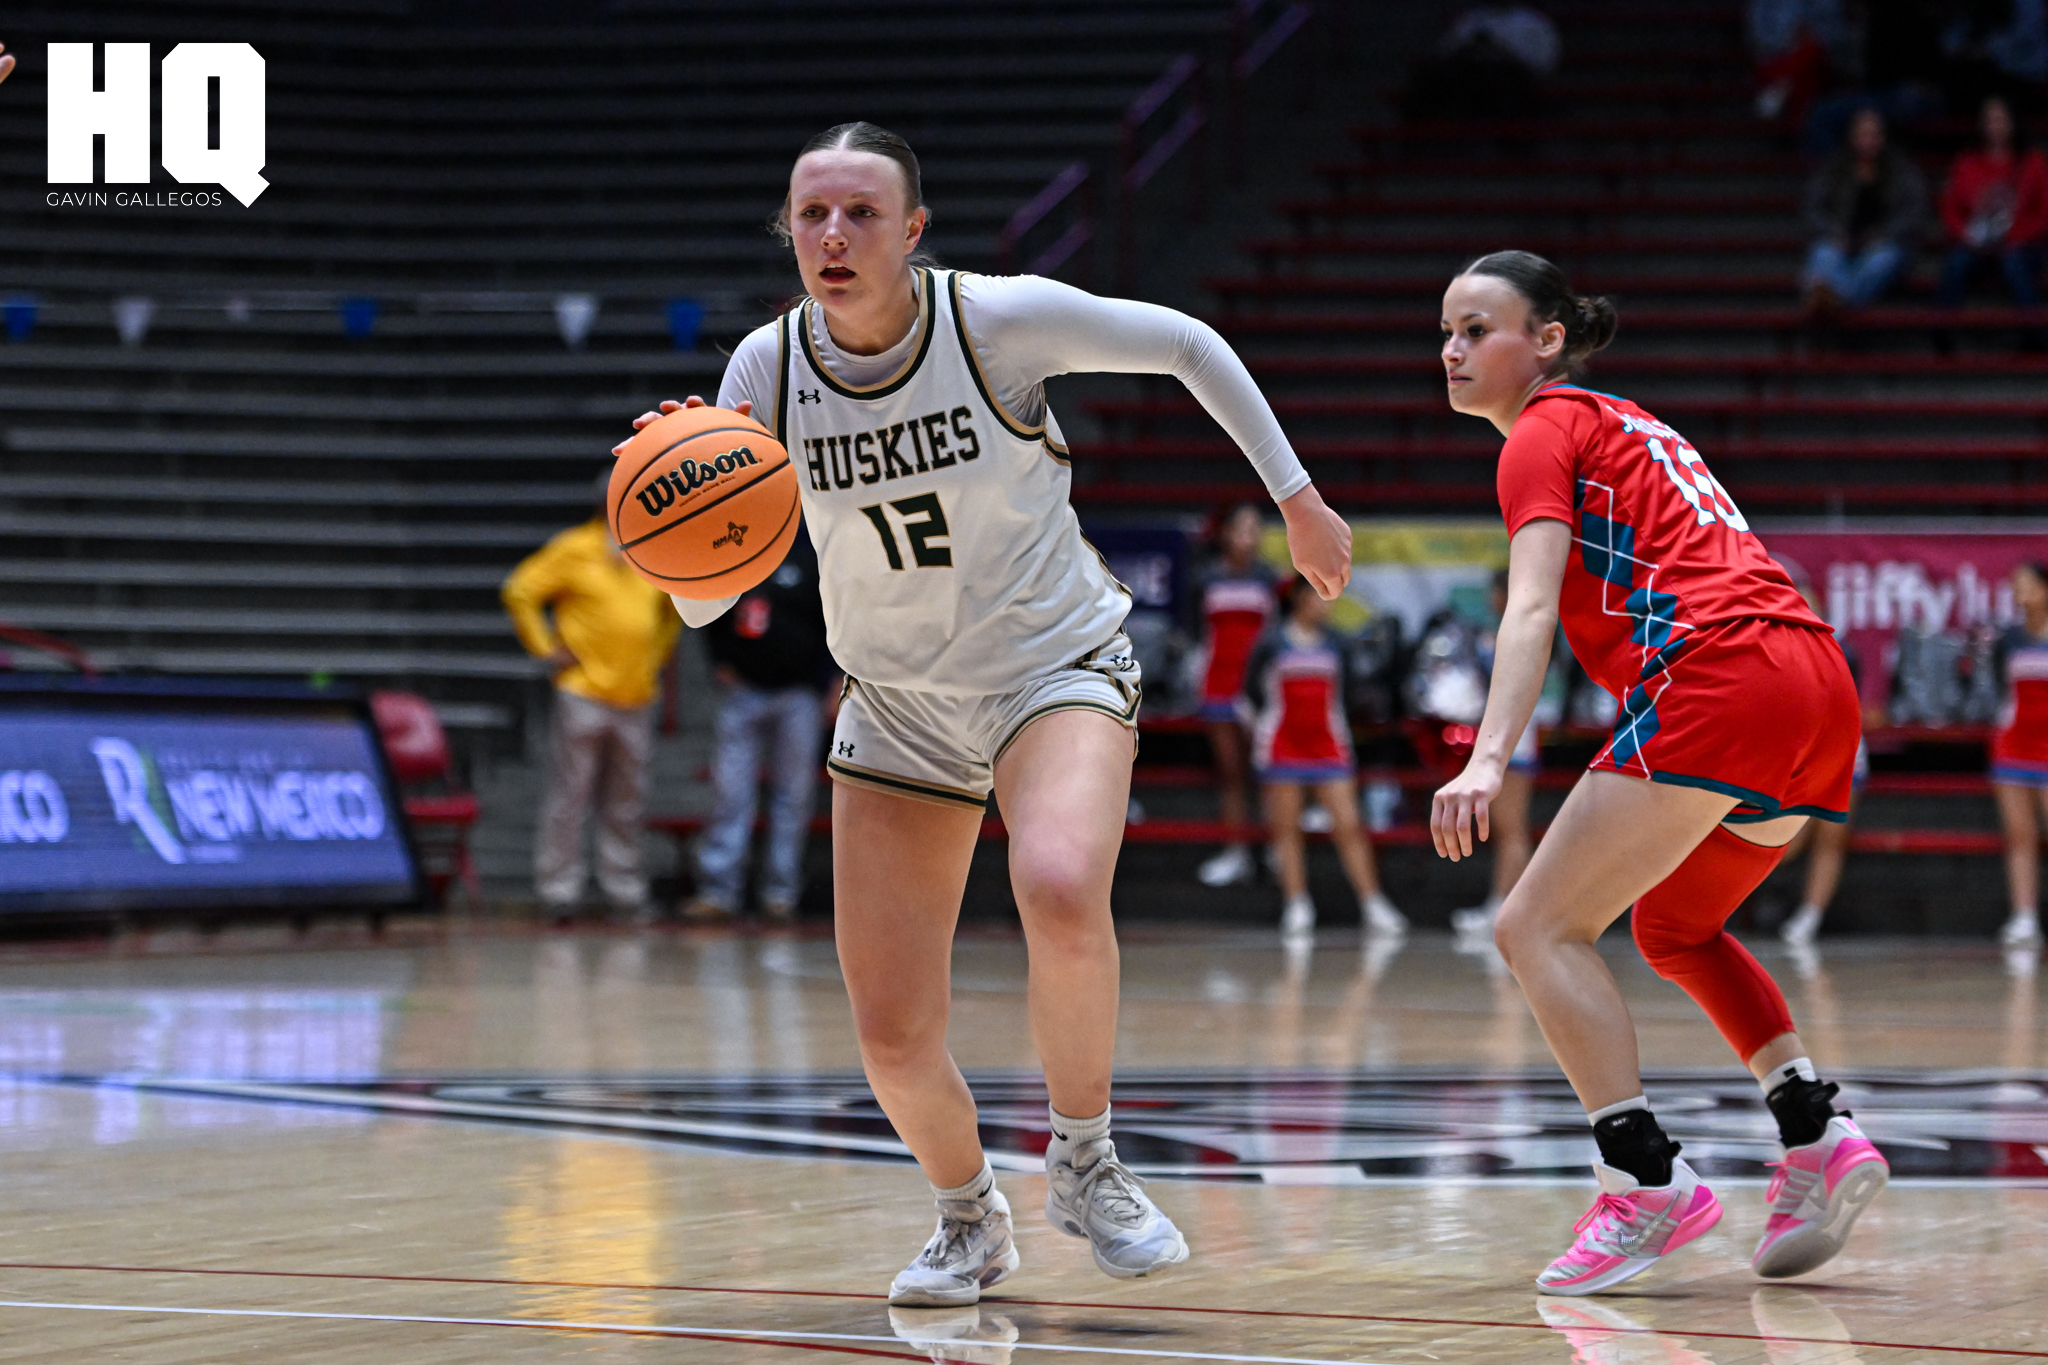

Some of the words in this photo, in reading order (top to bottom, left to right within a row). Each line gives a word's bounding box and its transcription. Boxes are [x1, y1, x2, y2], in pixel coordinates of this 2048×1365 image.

[636, 446, 758, 517] Wilson
[803, 405, 981, 491] HUSKIES
[712, 529, 741, 550] NMAA
[858, 491, 954, 572] 12
[166, 771, 256, 842] NEW
[250, 771, 385, 841] MEXICO
